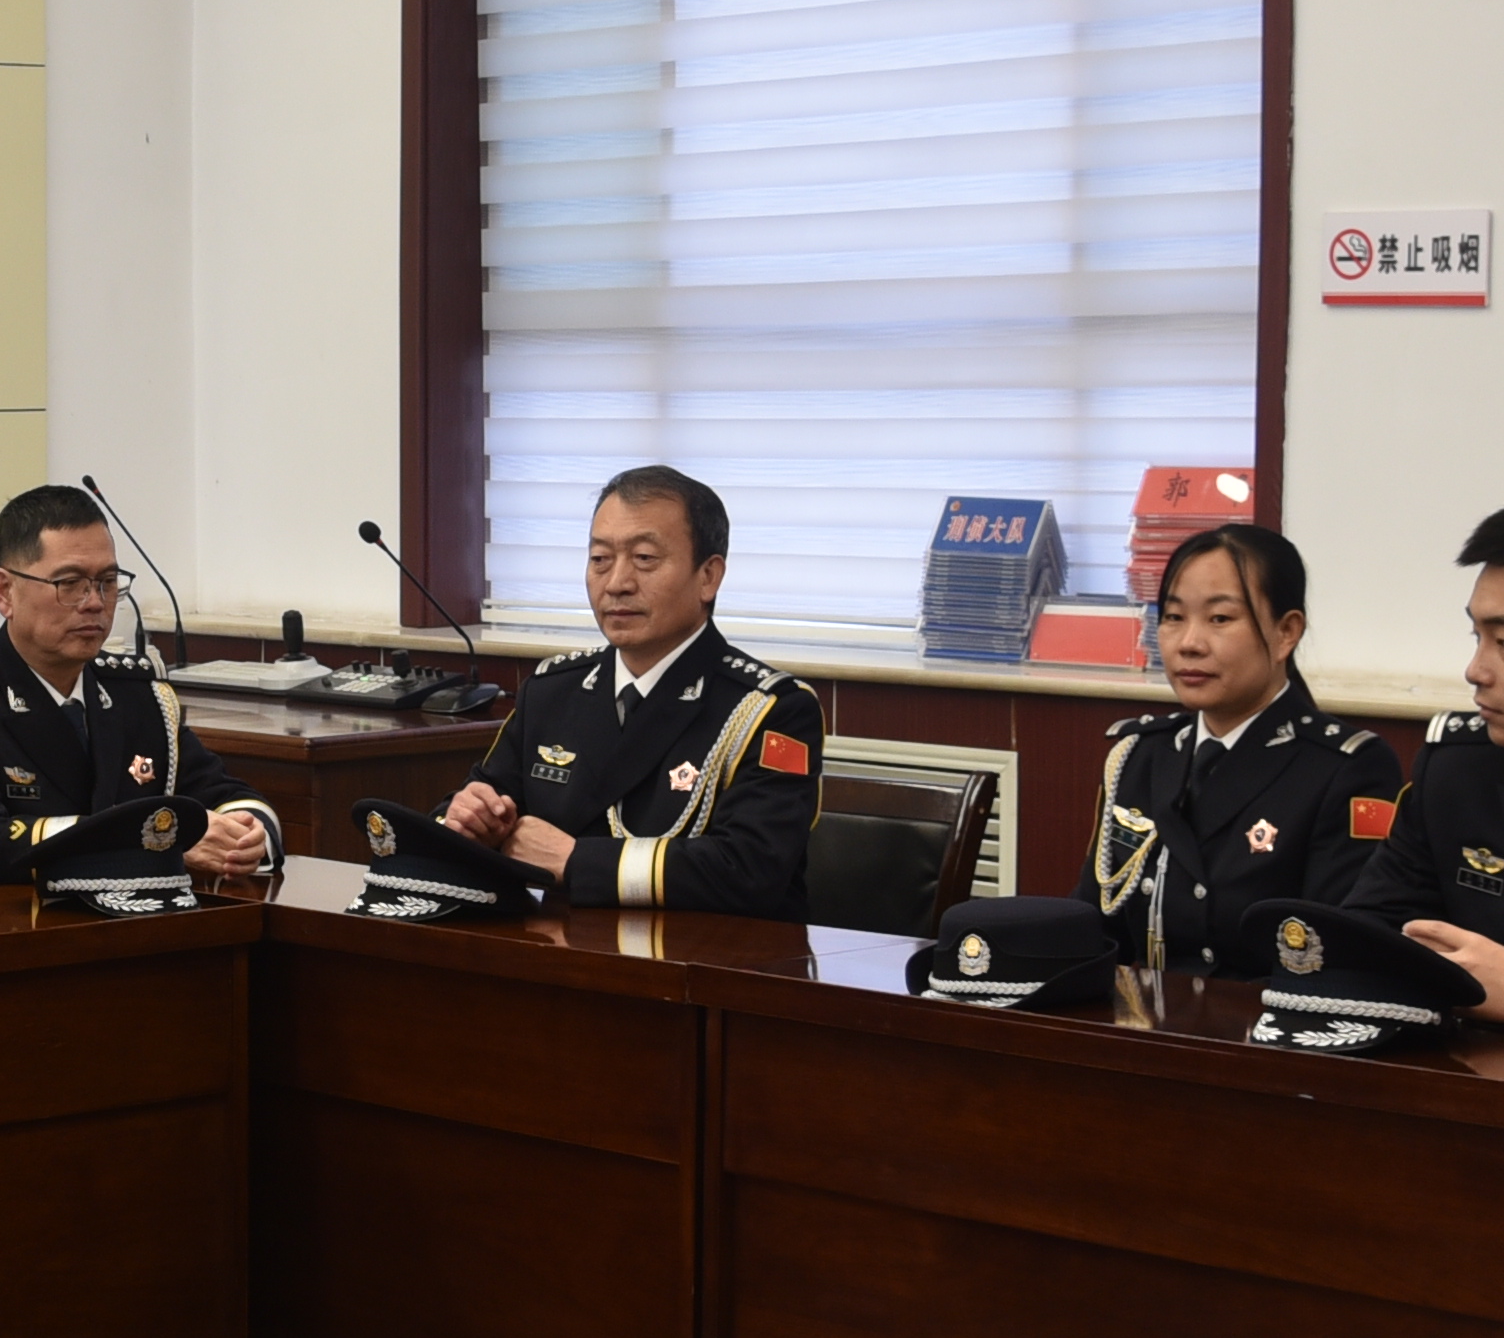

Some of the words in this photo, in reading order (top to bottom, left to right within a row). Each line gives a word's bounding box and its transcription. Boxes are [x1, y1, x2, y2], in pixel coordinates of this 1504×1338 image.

[1378, 234, 1480, 274] 禁止吸烟
[942, 515, 1026, 544] 刑侦大队
